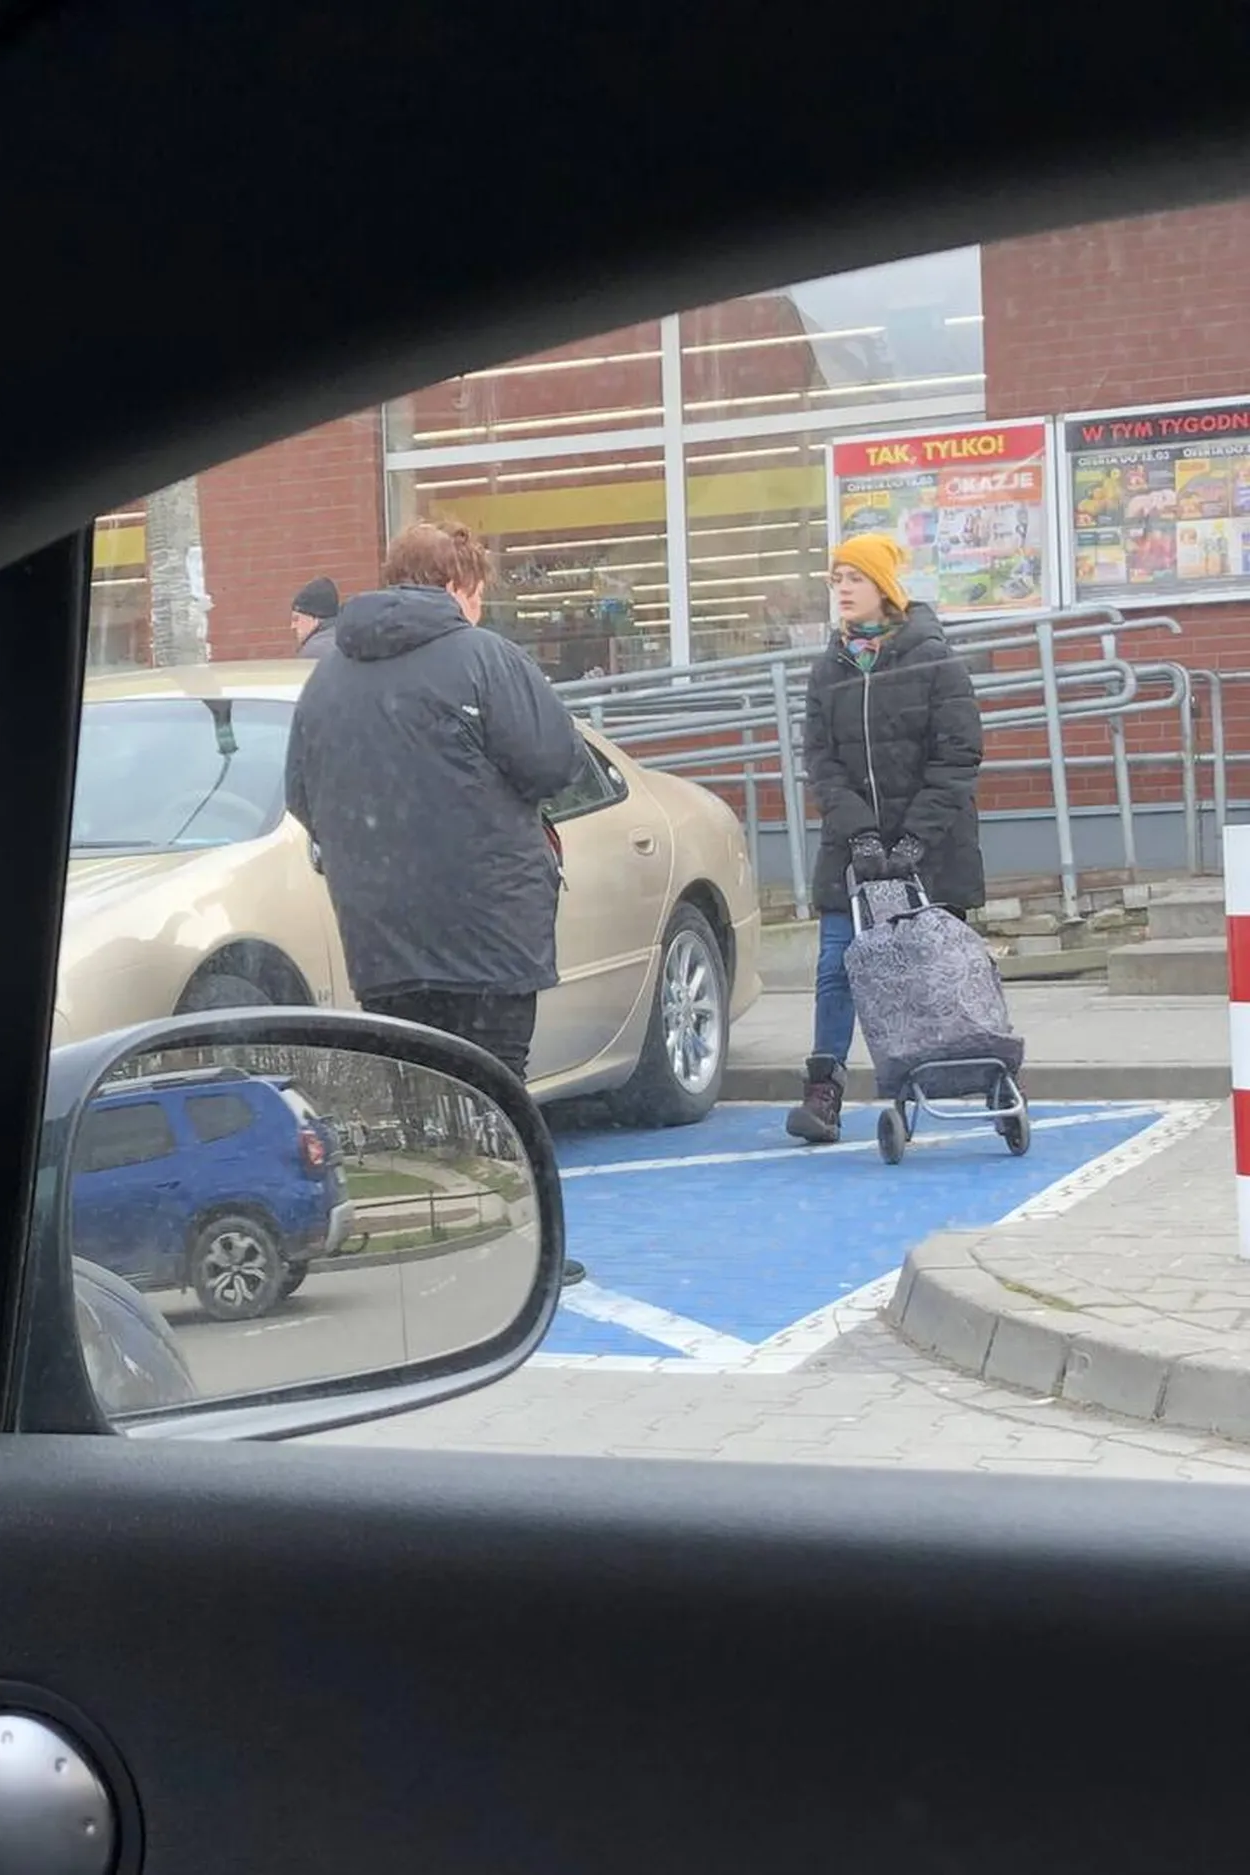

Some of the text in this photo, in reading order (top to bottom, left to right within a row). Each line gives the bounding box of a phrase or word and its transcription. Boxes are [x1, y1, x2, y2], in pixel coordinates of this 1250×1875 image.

[1082, 411, 1250, 443] W TYM TYGODN
[866, 434, 1005, 466] TAK, TYLKO!
[946, 471, 1034, 495] OKAZJE
